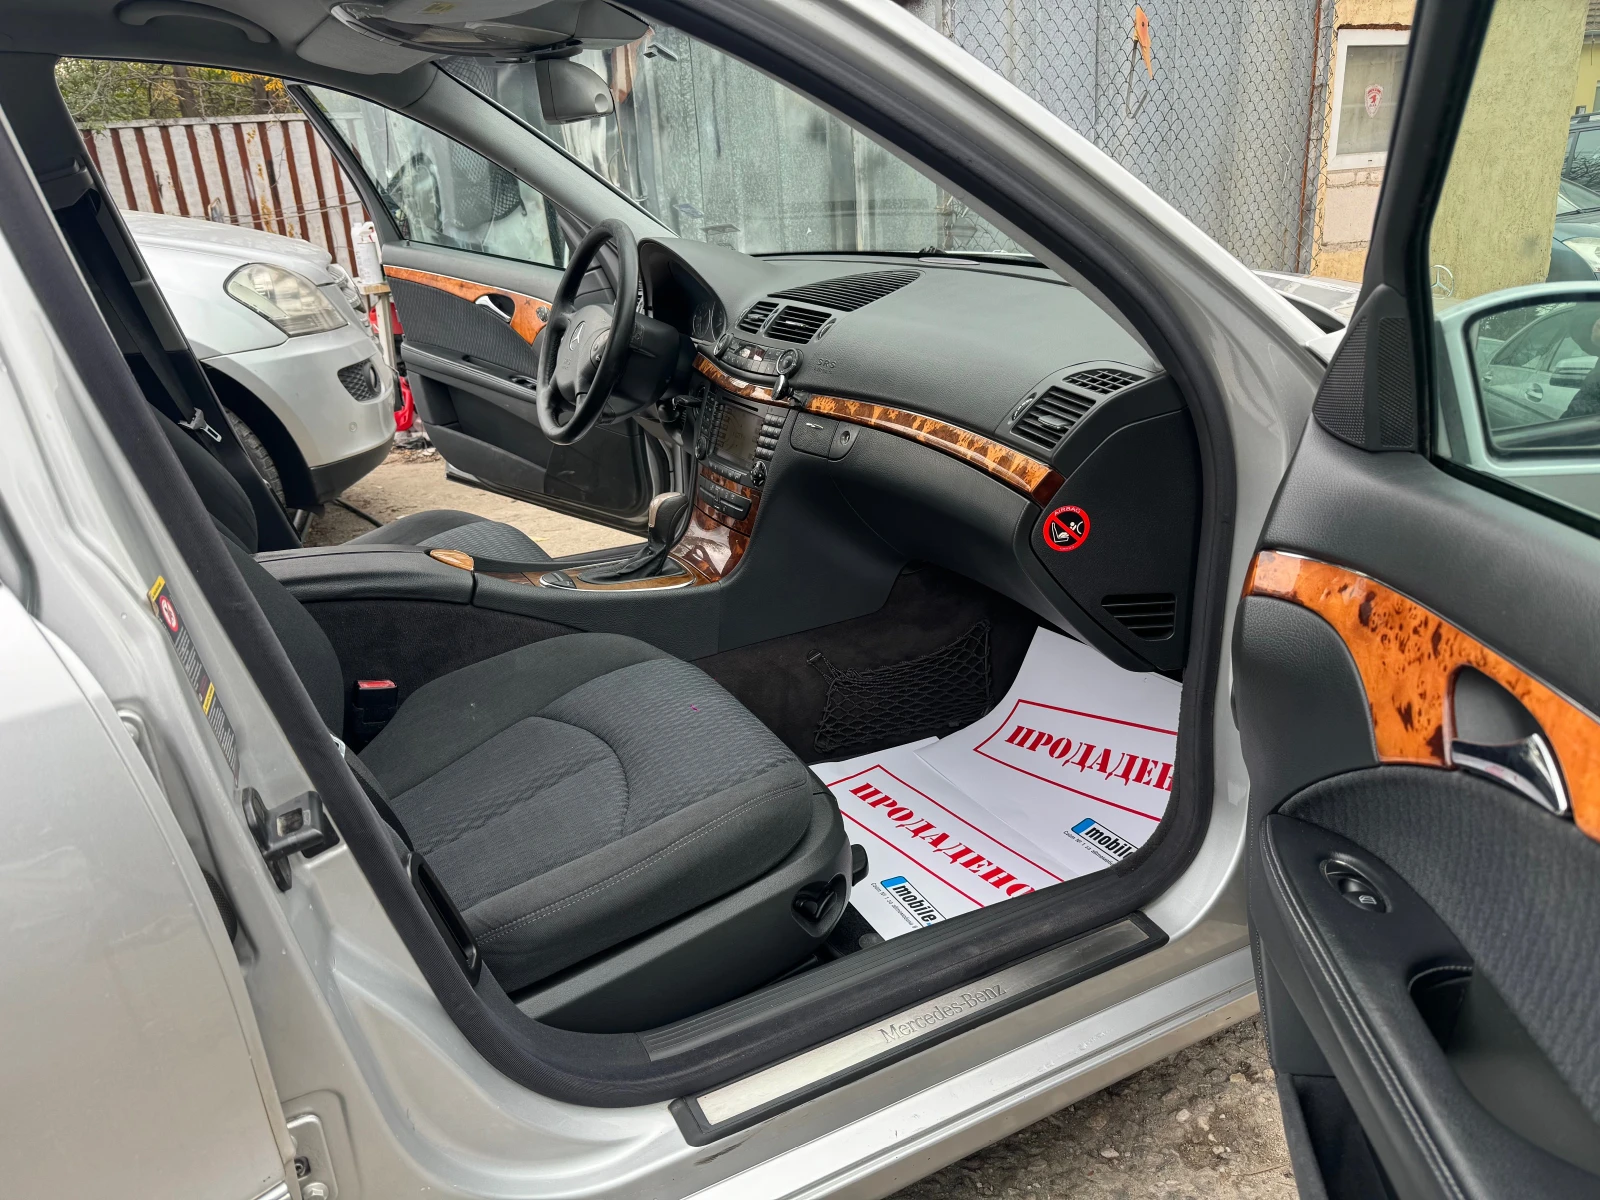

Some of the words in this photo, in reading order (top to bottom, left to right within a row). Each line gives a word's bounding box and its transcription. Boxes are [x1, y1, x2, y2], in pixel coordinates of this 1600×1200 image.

[817, 358, 837, 369] SRS
[1054, 506, 1081, 516] AIRBAG
[878, 984, 1007, 1044] Mercedes-Benz
